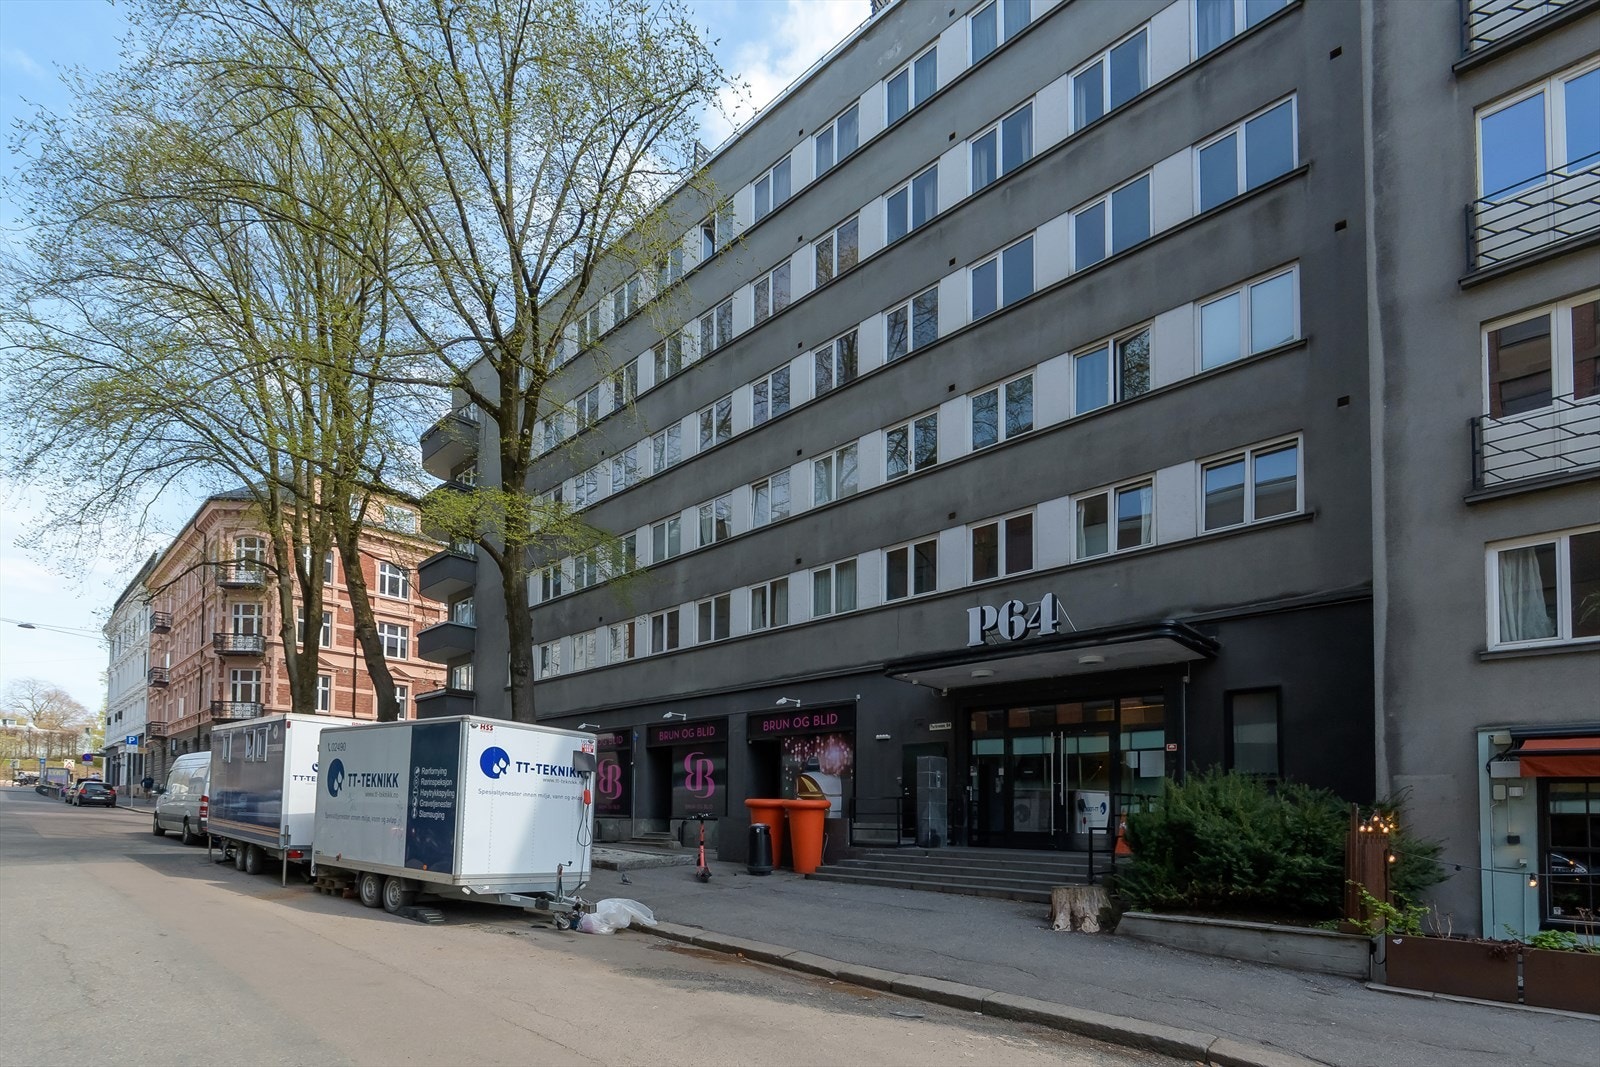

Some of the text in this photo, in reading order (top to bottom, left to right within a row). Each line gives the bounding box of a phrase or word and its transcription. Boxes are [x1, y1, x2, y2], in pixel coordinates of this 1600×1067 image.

[966, 592, 1058, 647] P64
[763, 713, 838, 732] BRUN OG BLID
[608, 735, 624, 745] BLID
[659, 726, 716, 741] BRUN OG BLID
[331, 742, 346, 752] 02490
[348, 773, 399, 788] TT-TEKNIKK
